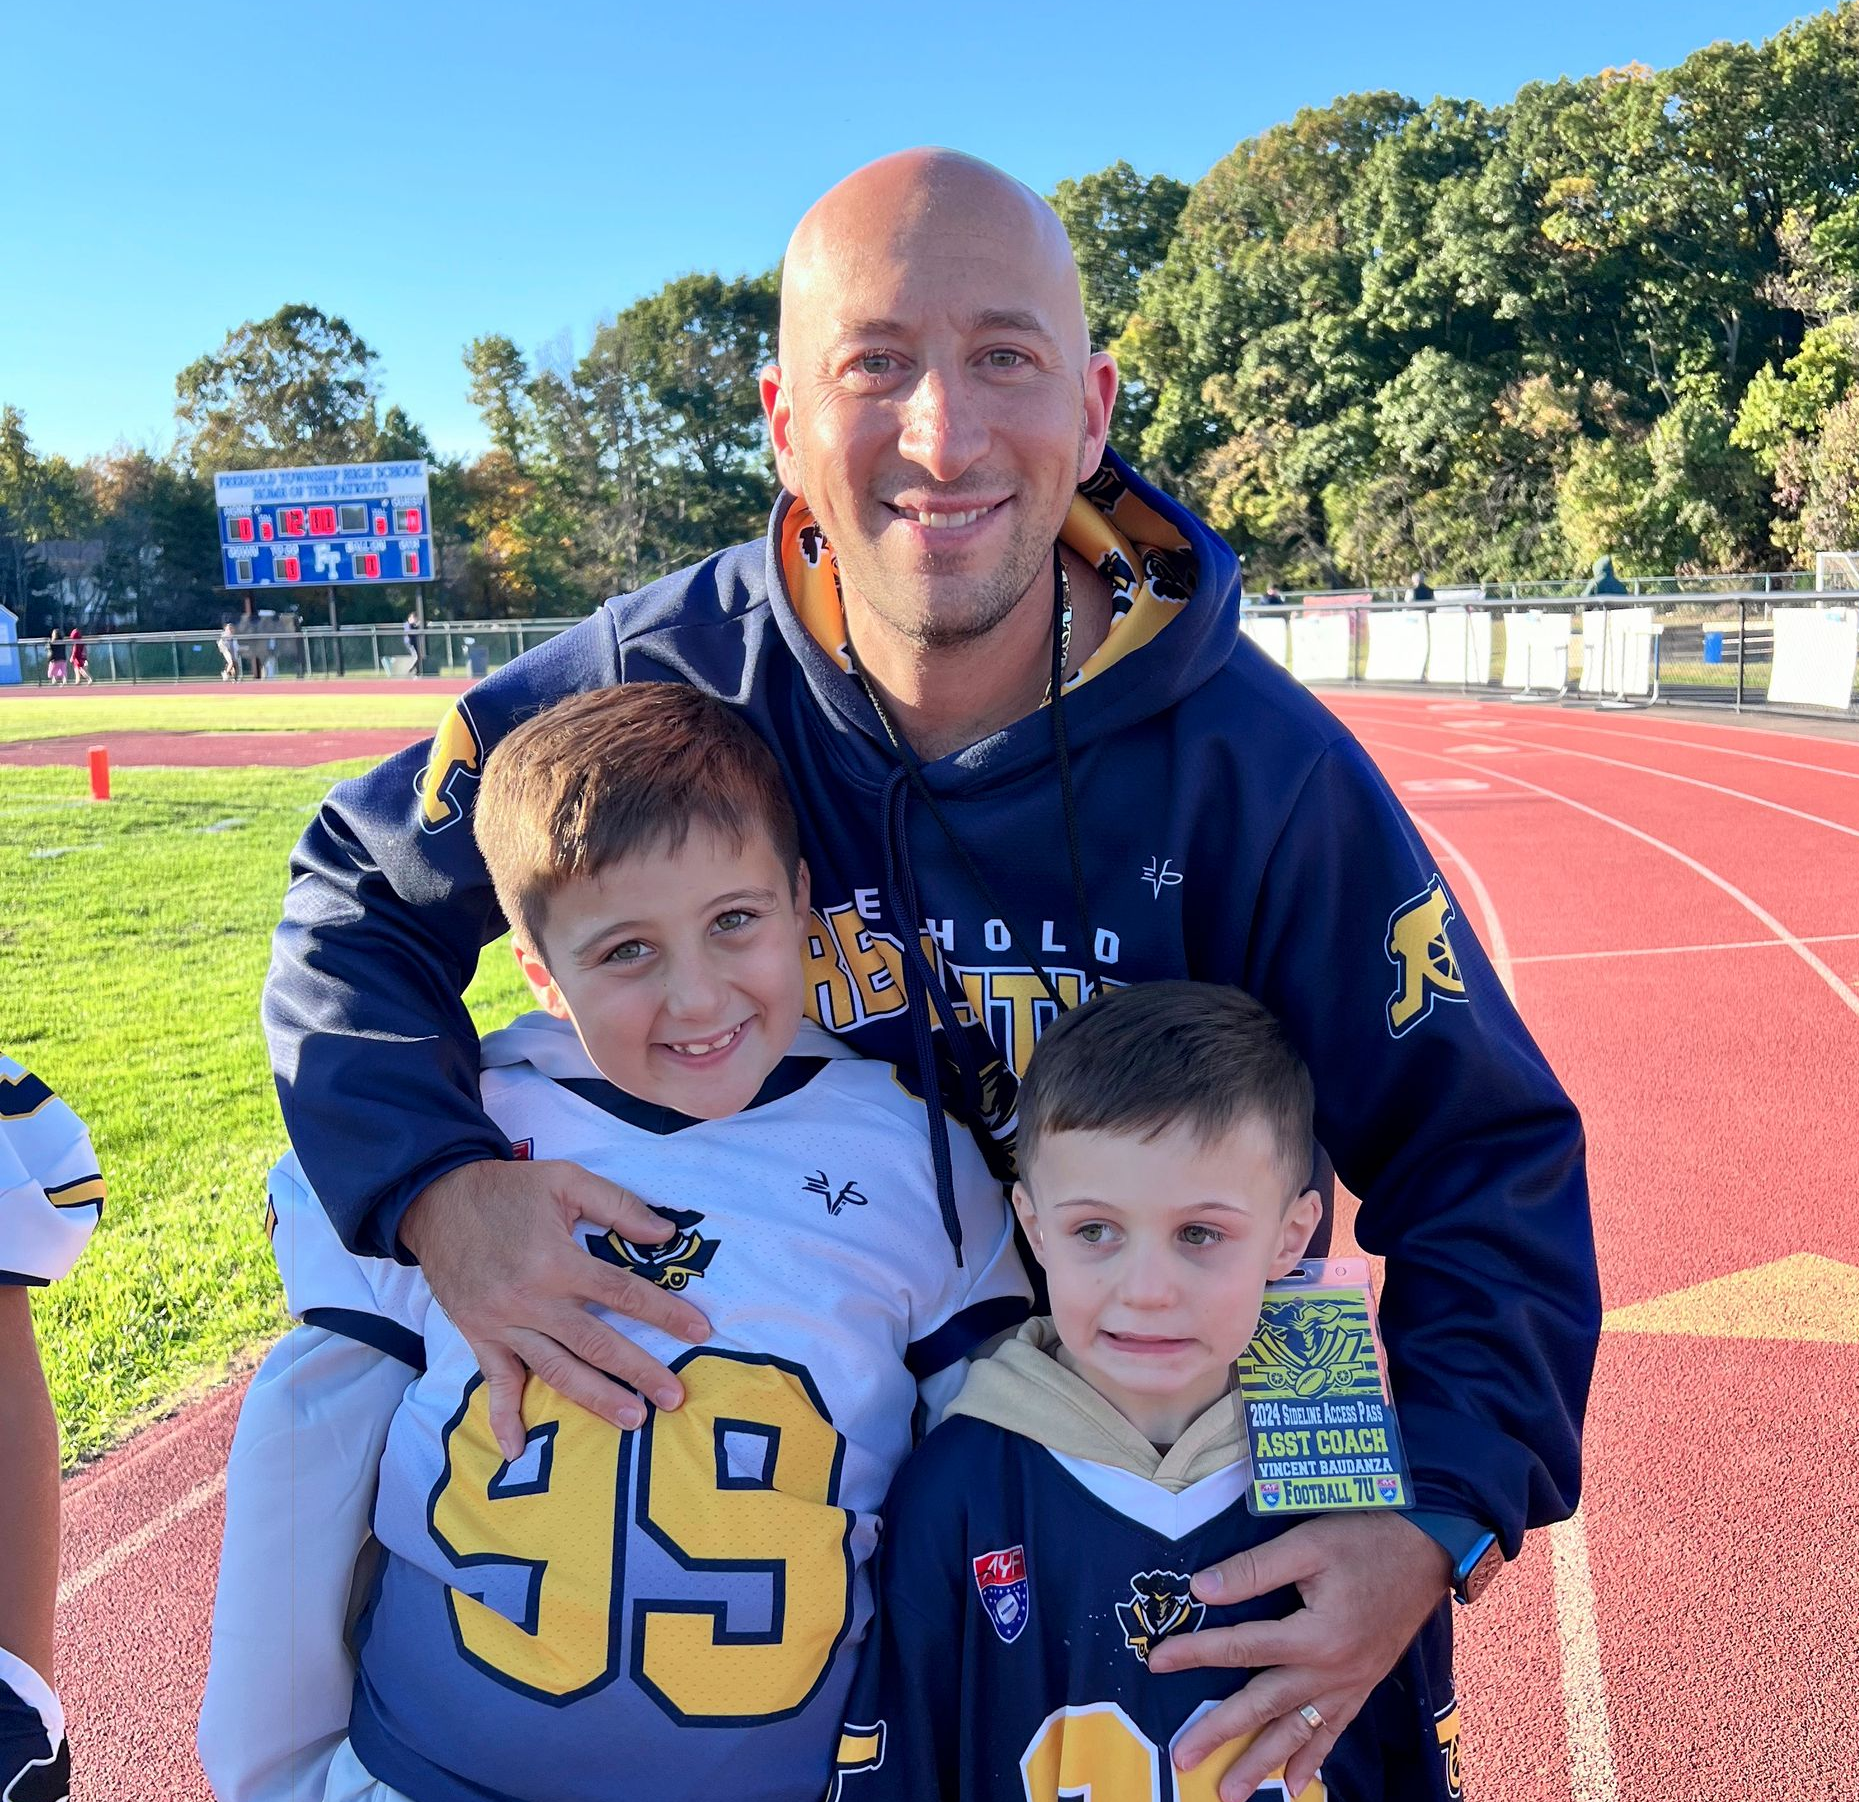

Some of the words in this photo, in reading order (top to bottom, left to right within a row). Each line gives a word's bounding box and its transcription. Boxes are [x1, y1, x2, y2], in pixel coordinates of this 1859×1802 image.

[218, 472, 276, 488] FREEHOLD
[279, 470, 338, 485] TOWNSHIP
[344, 467, 373, 480] HIGH
[376, 463, 423, 478] SCHOOL
[333, 482, 389, 496] PATRIOTS
[1250, 1402, 1281, 1427] 2024
[1282, 1403, 1323, 1425] SIDELINE
[1324, 1402, 1358, 1424] ACCESS
[1357, 1401, 1383, 1422] PASS
[1256, 1431, 1311, 1458] ASST
[1316, 1428, 1389, 1455] COACH
[1258, 1461, 1316, 1478] VINCENT
[1319, 1458, 1393, 1476] BAUDANZA
[1282, 1480, 1352, 1505] FOOTBALL
[1353, 1477, 1376, 1502] 7U
[427, 1345, 857, 1728] 99
[982, 1550, 1021, 1581] AYF
